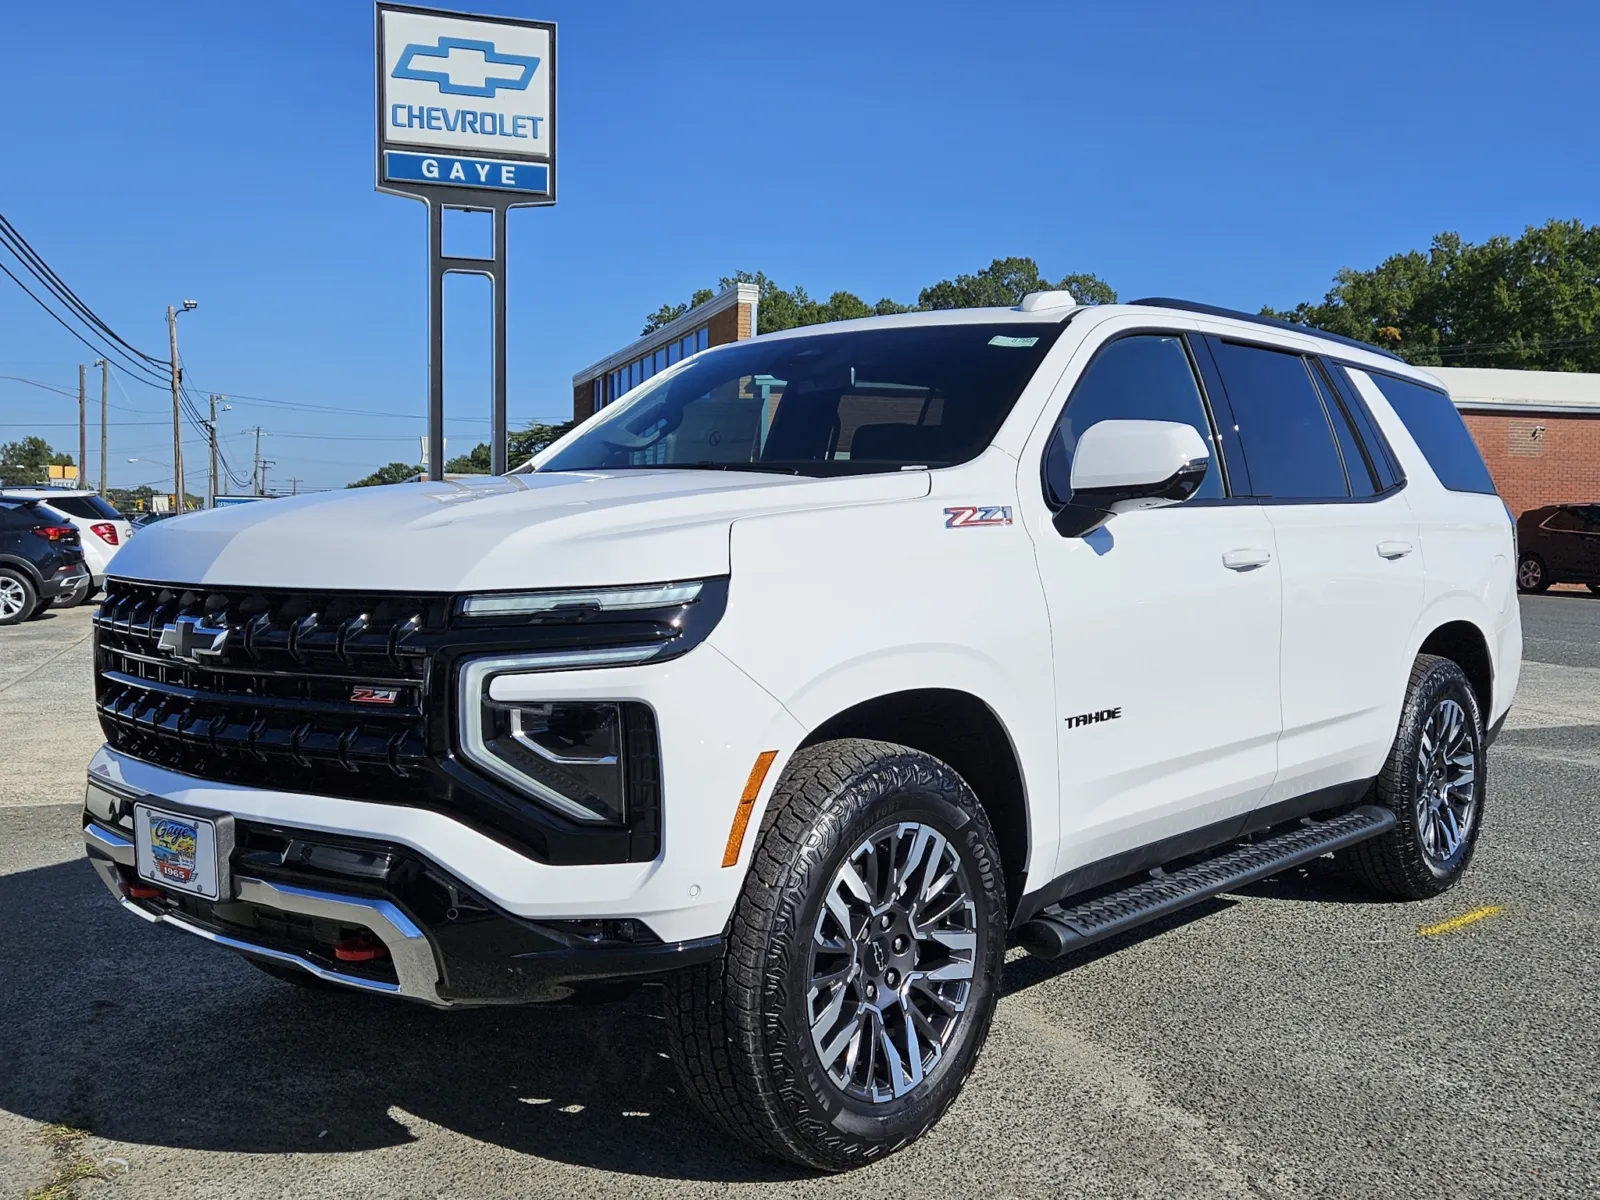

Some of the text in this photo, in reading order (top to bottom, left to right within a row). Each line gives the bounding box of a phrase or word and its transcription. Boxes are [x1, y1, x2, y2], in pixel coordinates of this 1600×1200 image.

[391, 103, 544, 139] CHEVROLET
[421, 159, 516, 185] GAYE
[943, 506, 1013, 529] Z71
[350, 688, 398, 704] Z71
[1064, 706, 1122, 729] TAHOE
[155, 819, 189, 844] Gaye
[164, 866, 185, 880] 1965
